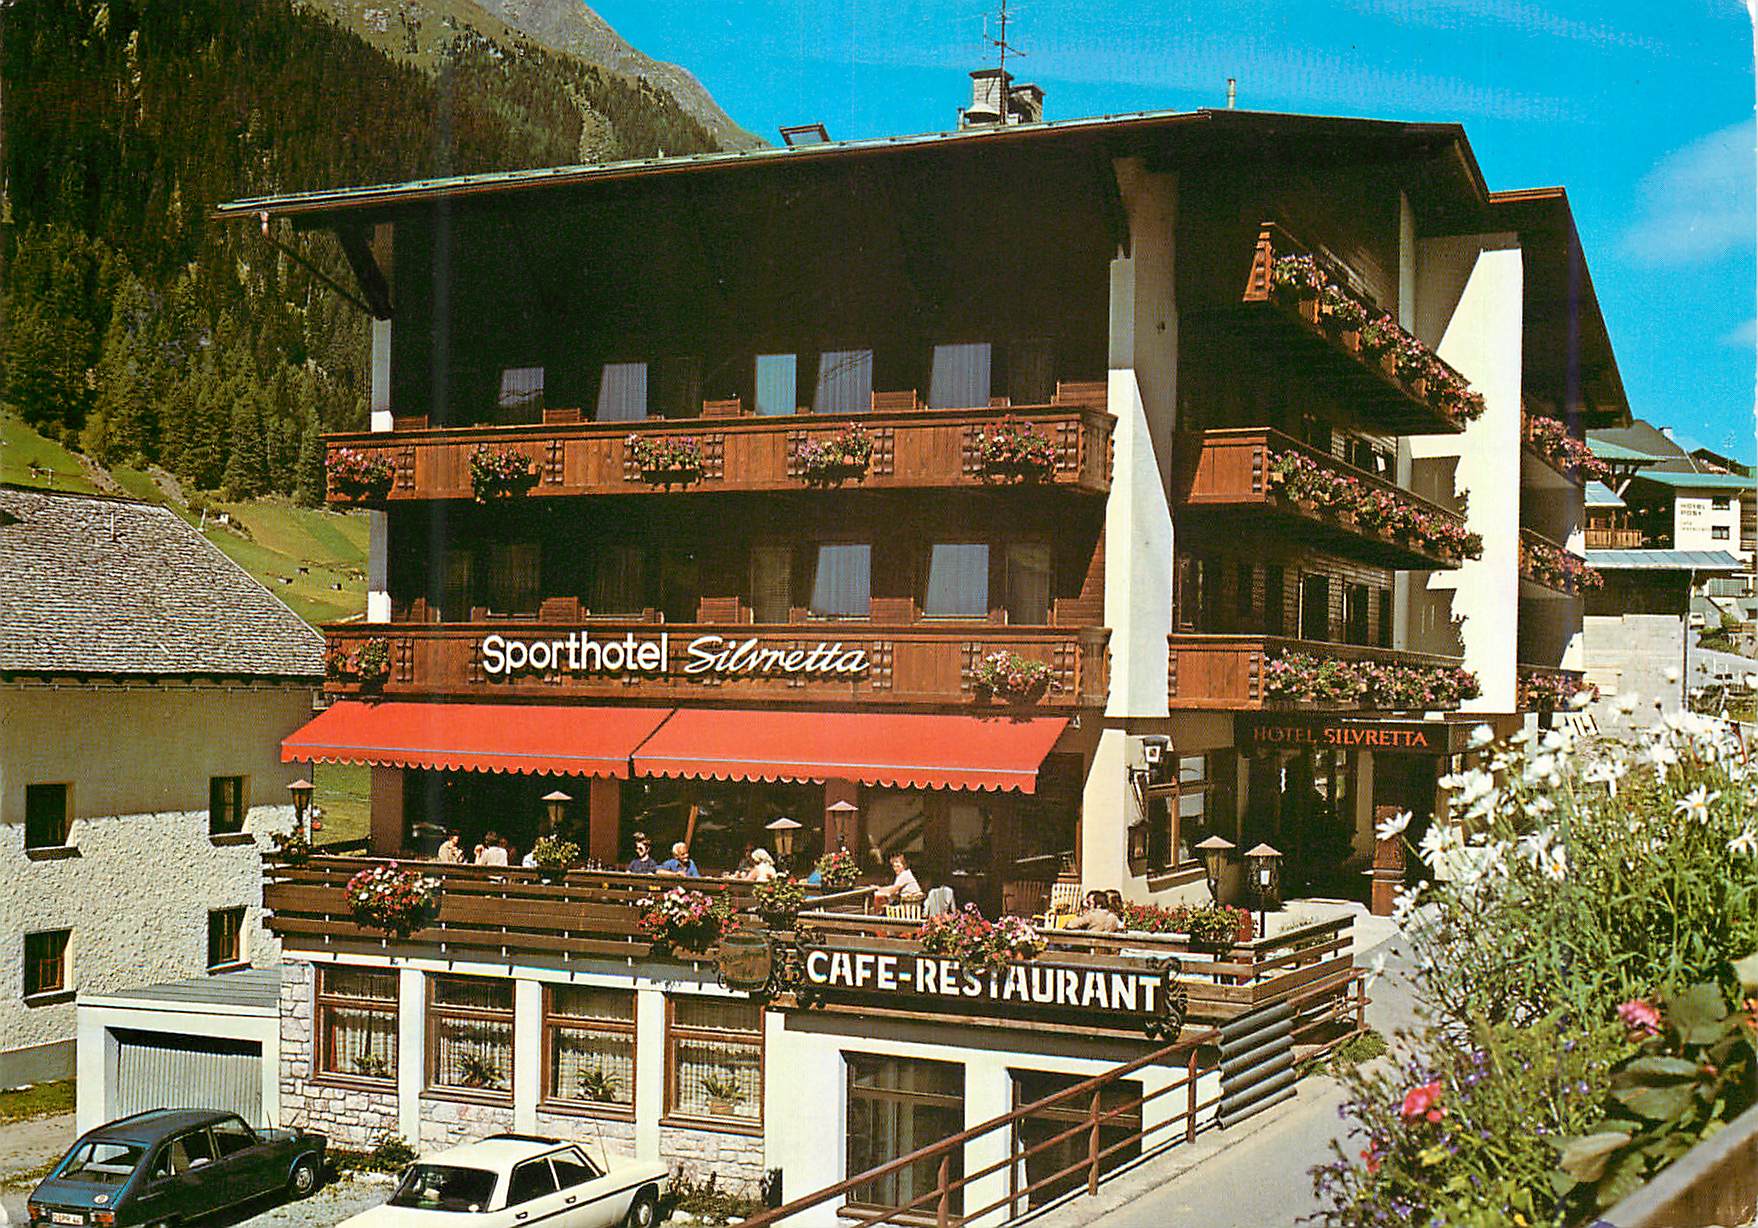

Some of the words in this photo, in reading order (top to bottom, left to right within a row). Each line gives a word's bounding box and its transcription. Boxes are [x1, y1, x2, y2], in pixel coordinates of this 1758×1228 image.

[482, 632, 668, 674] Sporthotel
[684, 636, 870, 674] Silvretta
[1253, 726, 1317, 743] HOTEL
[1324, 728, 1428, 747] SILVRETTA
[806, 950, 1161, 1012] CAFE-RESTAURANT
